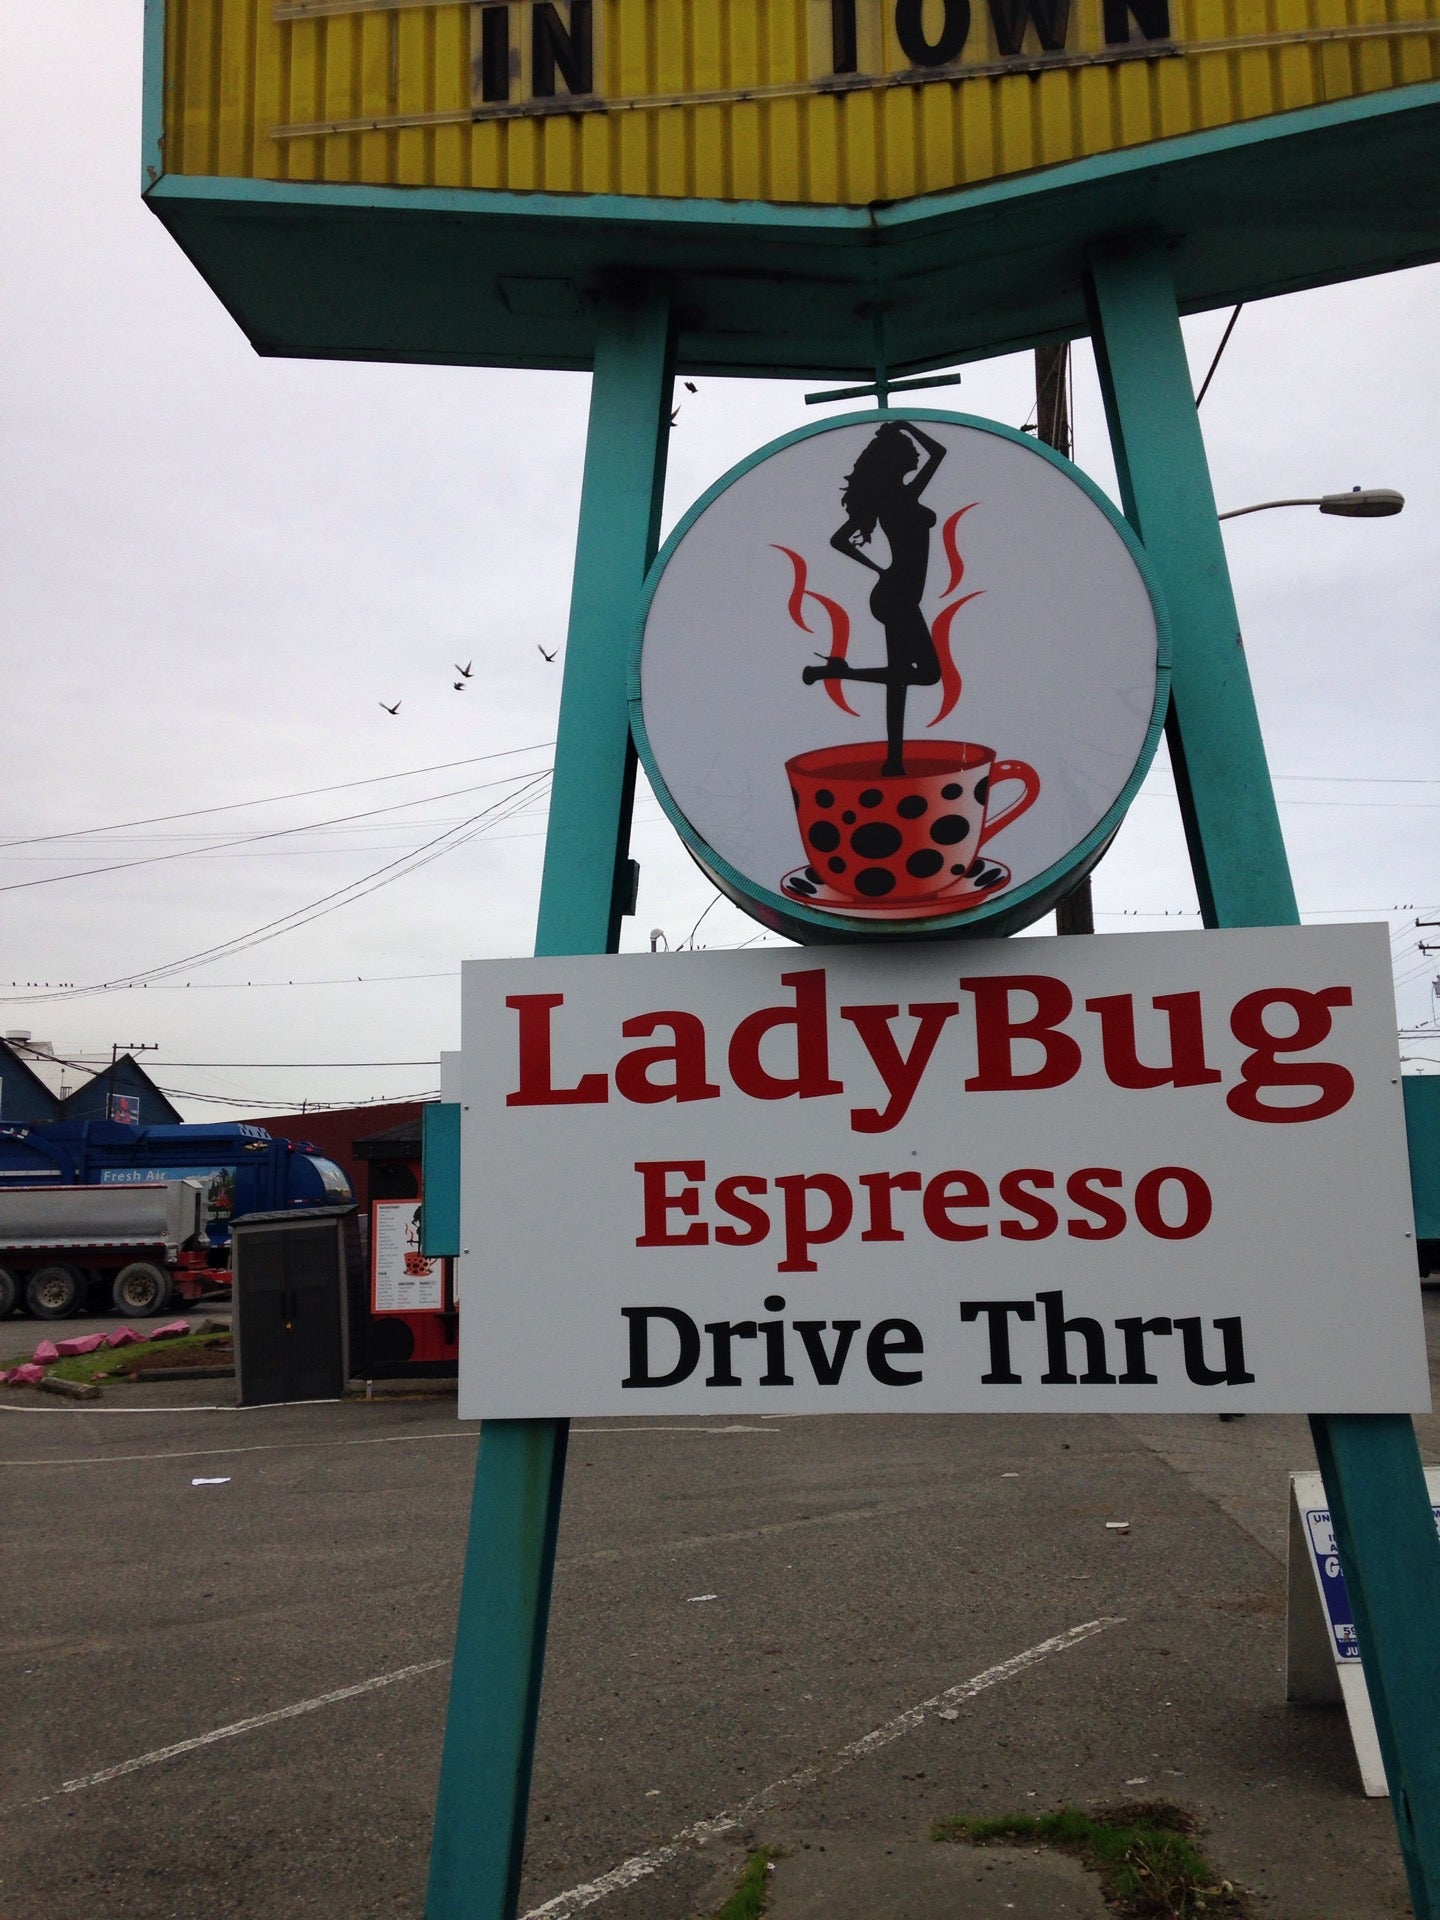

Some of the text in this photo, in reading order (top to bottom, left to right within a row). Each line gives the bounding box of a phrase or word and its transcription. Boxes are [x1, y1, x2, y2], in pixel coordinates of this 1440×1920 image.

[481, 1, 594, 103] IN
[505, 968, 1355, 1134] LadyBug
[103, 1170, 167, 1181] Fresh Air
[634, 1159, 1213, 1273] Espresso
[620, 1289, 1256, 1389] Drive Thru
